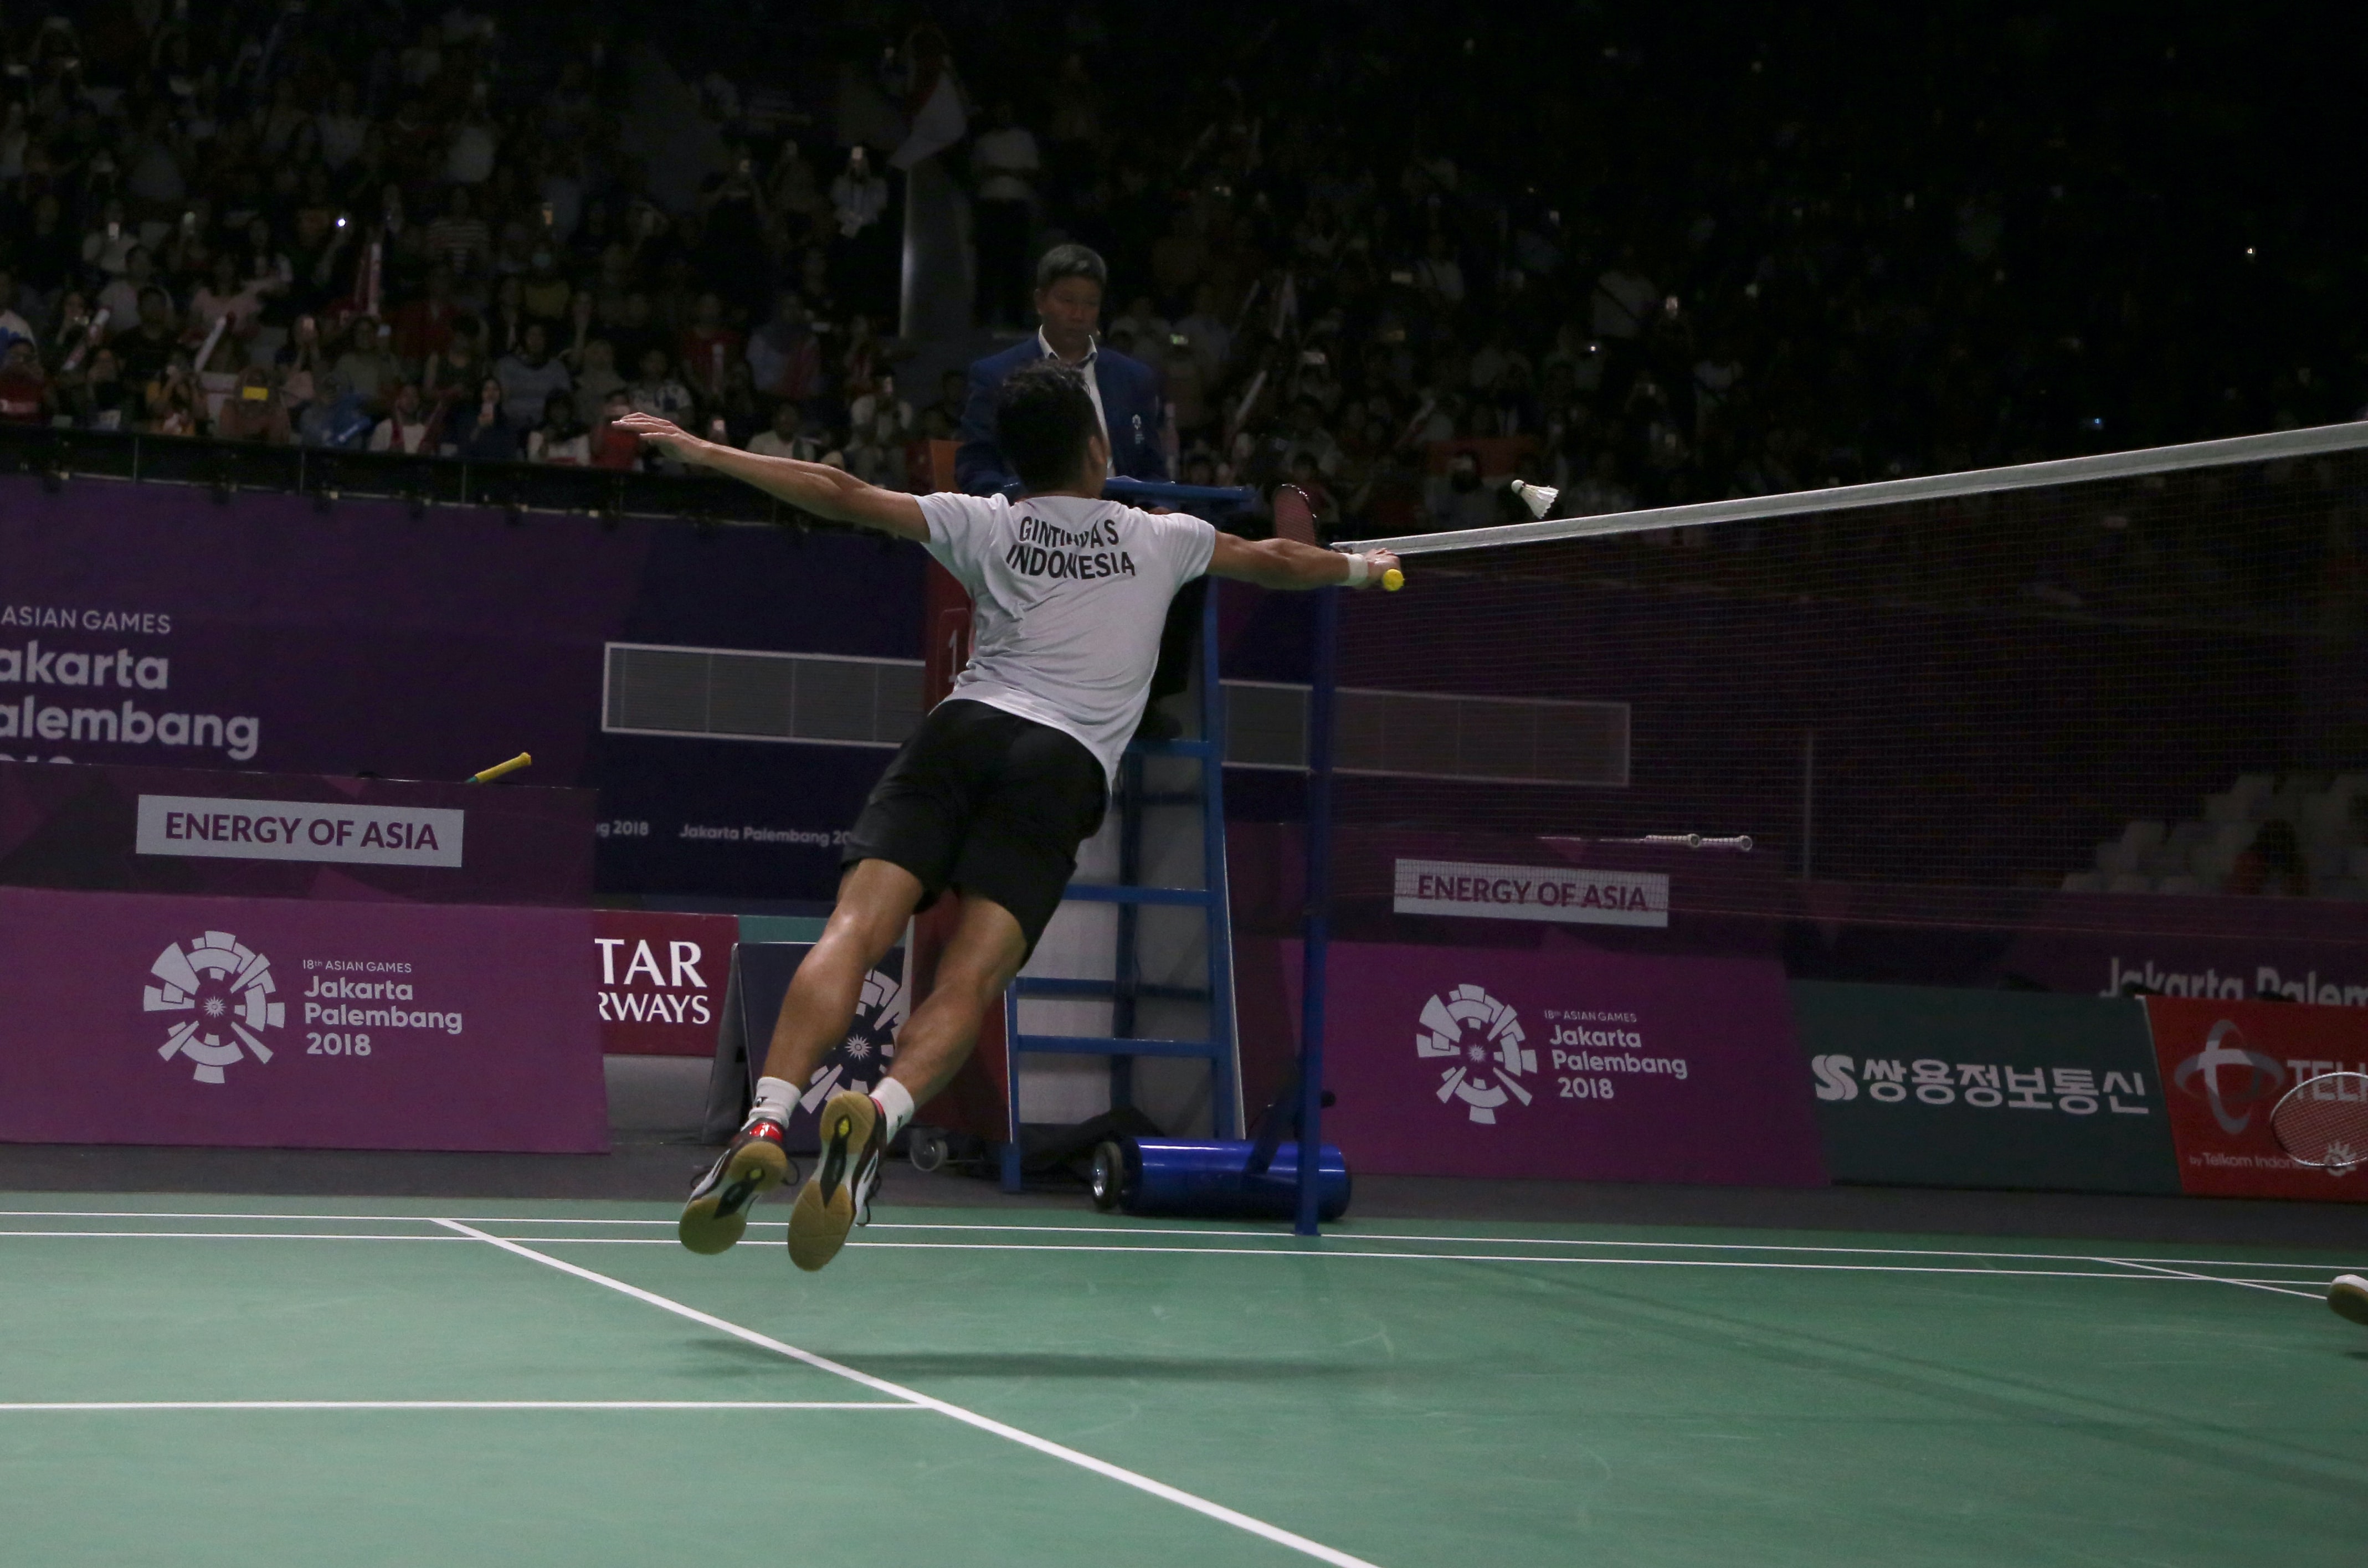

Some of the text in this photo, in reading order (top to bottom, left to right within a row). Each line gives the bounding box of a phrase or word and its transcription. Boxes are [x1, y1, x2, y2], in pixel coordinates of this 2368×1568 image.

[1006, 544, 1136, 580] INDONESIA
[2, 606, 171, 634] ASIAN GAMES
[166, 812, 439, 850] ENERGY OF ASIA
[613, 820, 649, 836] 2018
[679, 823, 739, 840] Jakarta
[743, 826, 830, 847] Palembang
[1417, 875, 1648, 912] ENERGY OF ASIA
[325, 960, 363, 971] ASIAN
[366, 962, 412, 973] GAMES
[594, 938, 708, 988] TAR
[304, 975, 413, 1000] Jakarta
[305, 1002, 463, 1035] Palembang
[1564, 1010, 1596, 1021] ASIAN
[1598, 1011, 1637, 1023] GAMES
[306, 1032, 372, 1056] 2018
[1550, 1024, 1642, 1048] Jakarta
[1552, 1049, 1688, 1080] Palembang
[1557, 1077, 1615, 1099] 2018
[1863, 1058, 2150, 1115] 쌍용정보통신
